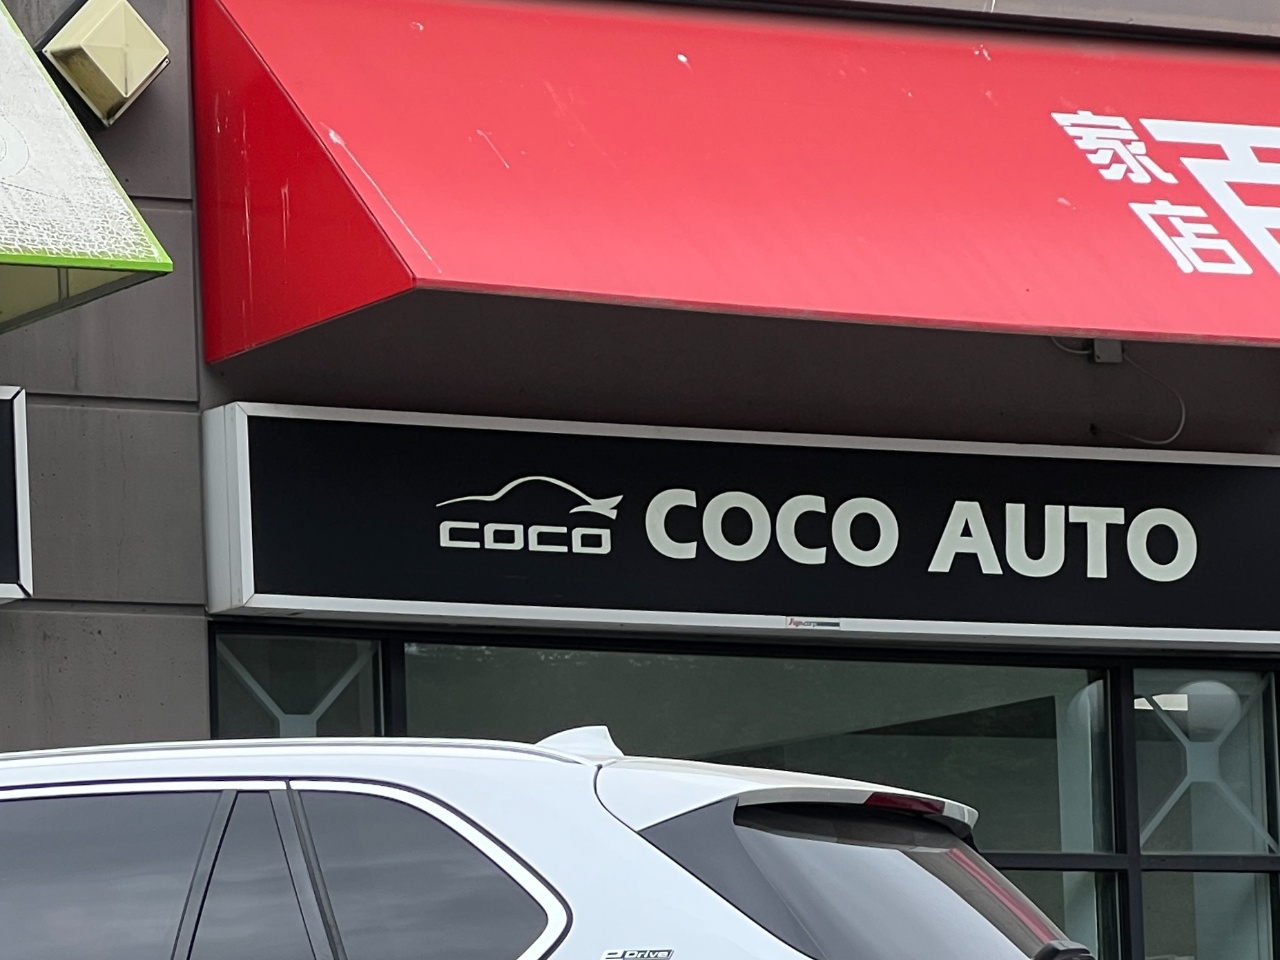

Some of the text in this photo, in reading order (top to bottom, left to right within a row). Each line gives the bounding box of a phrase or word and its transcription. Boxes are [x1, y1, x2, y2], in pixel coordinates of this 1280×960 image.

[439, 520, 611, 555] COCO
[646, 489, 1197, 581] COCO AUTO
